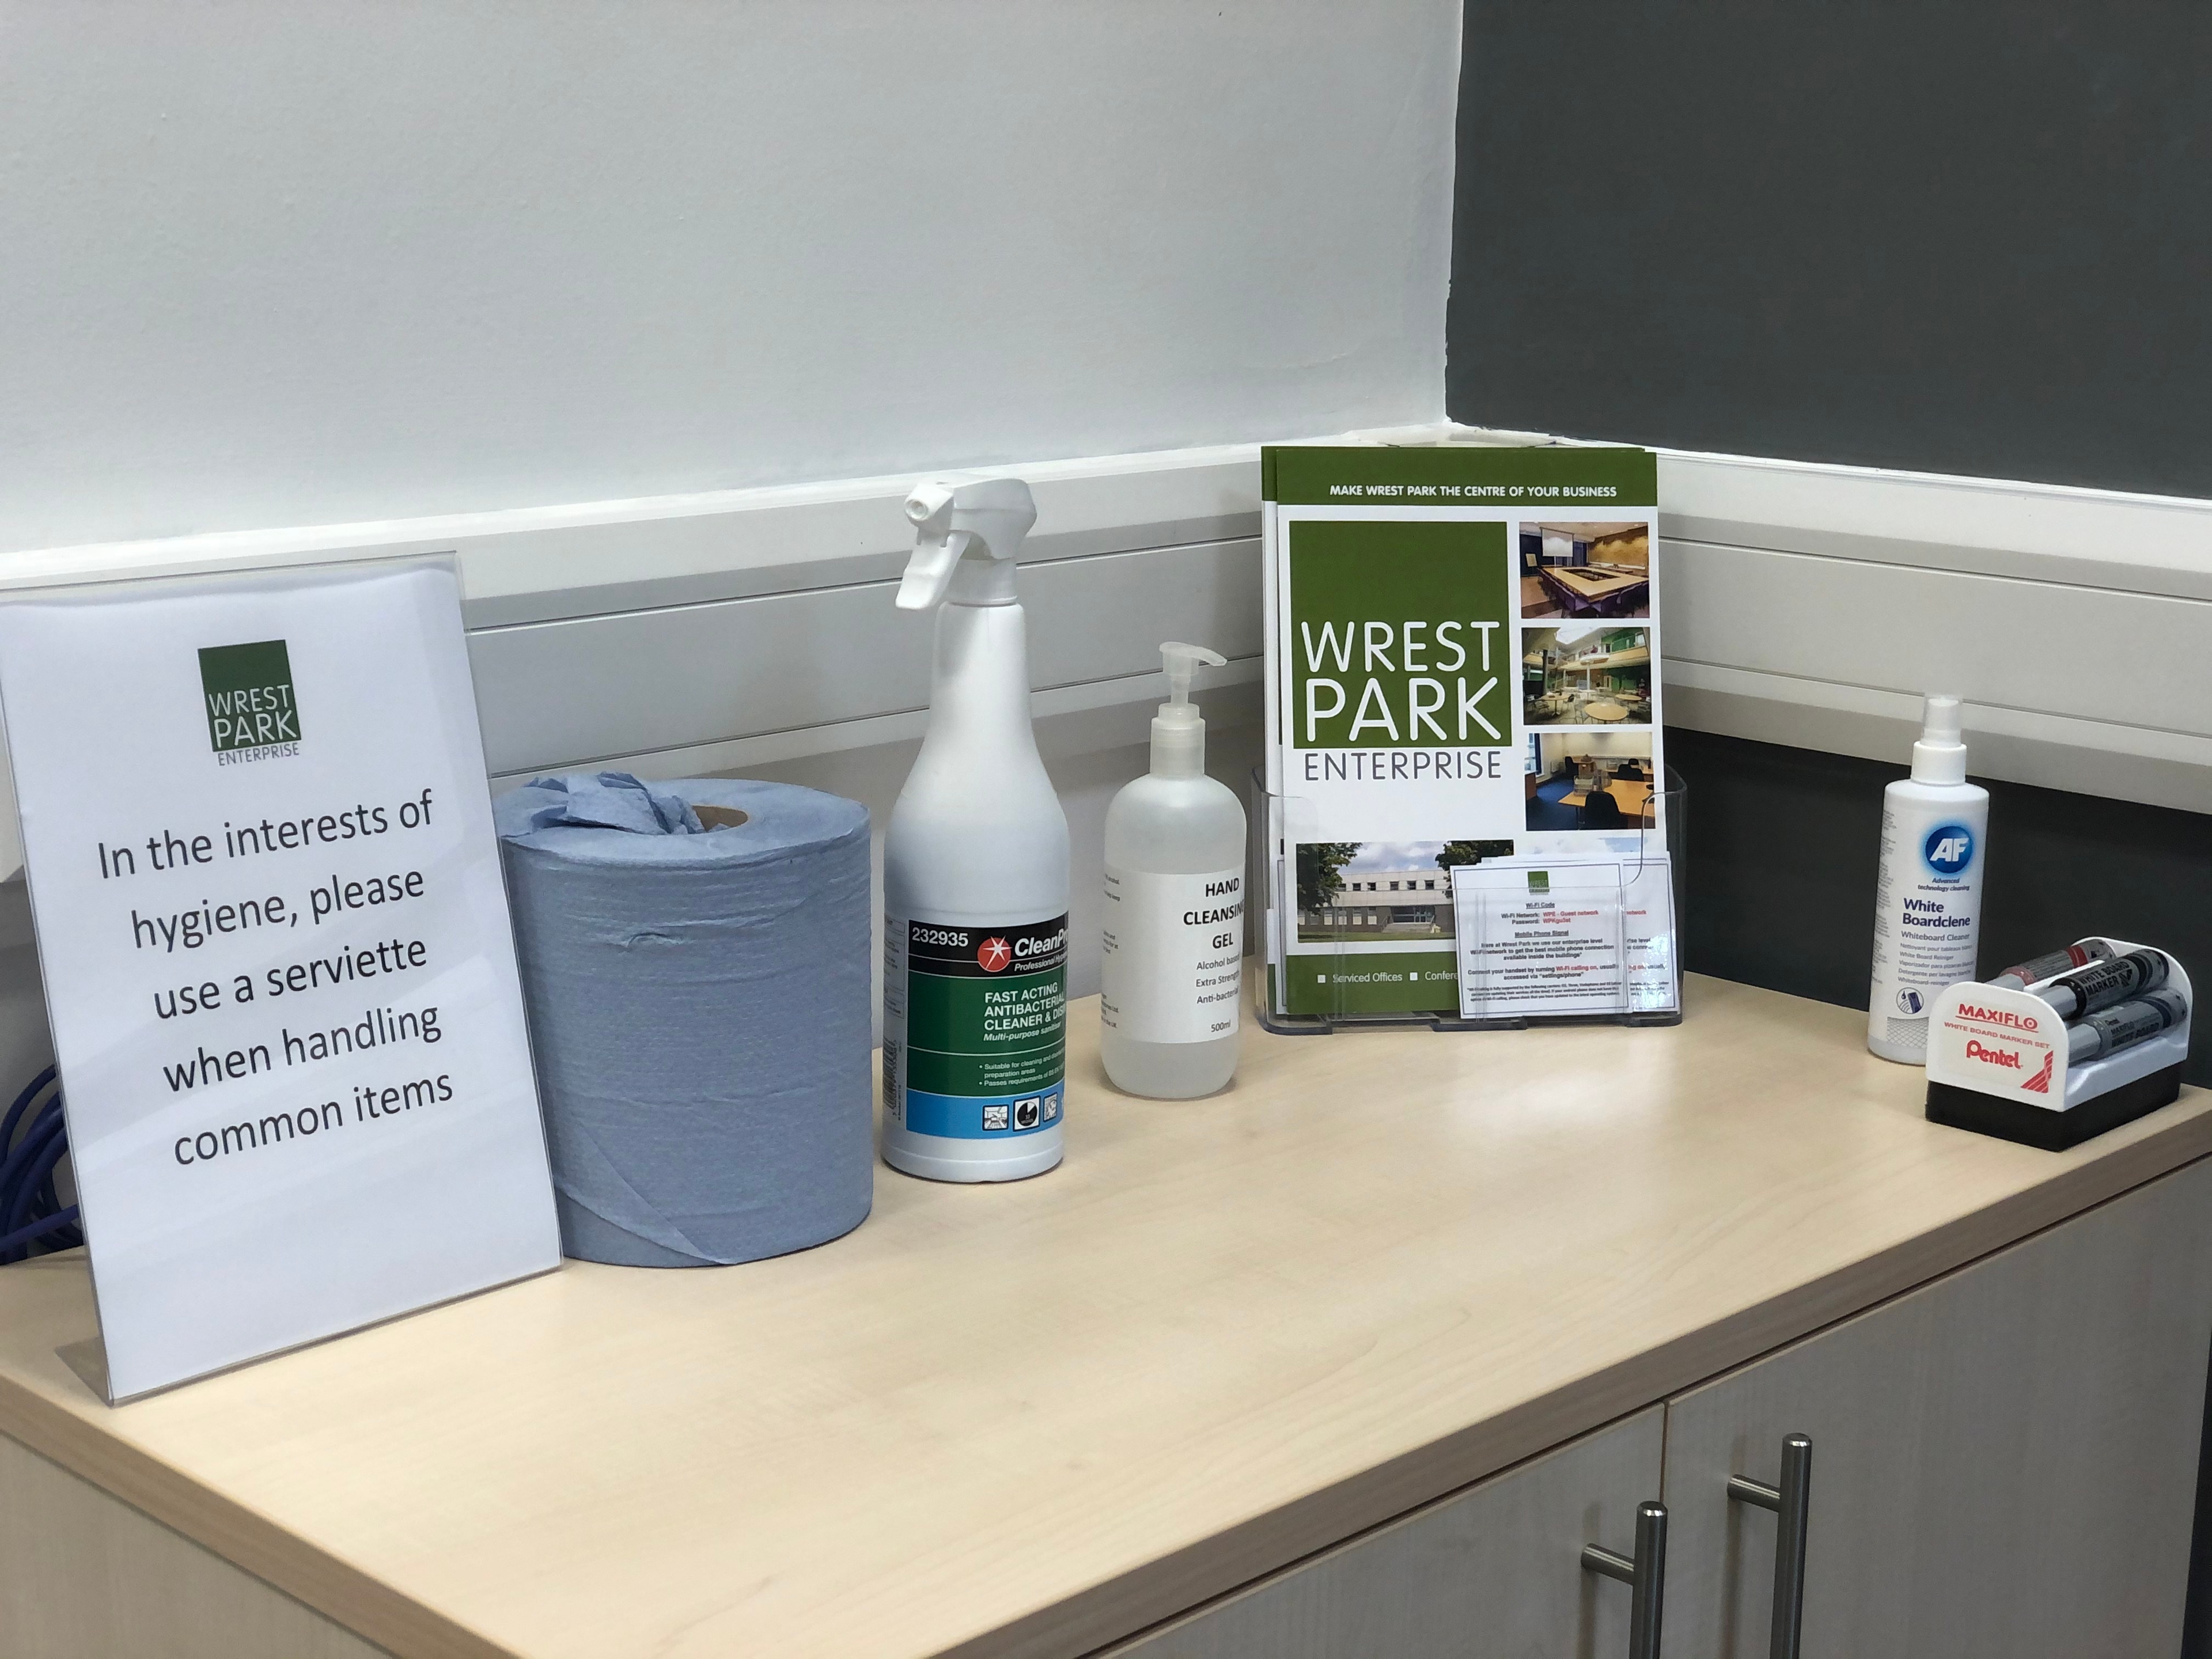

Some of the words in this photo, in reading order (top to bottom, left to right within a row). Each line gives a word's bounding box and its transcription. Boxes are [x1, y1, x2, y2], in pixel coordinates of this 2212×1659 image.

[1330, 485, 1362, 496] MAKE
[1366, 486, 1404, 496] WREST
[1407, 486, 1437, 496] PARK
[1440, 486, 1461, 497] THE
[1464, 486, 1505, 497] CENTRE
[1509, 486, 1524, 497] OF
[1527, 486, 1559, 497] YOUR
[1563, 486, 1617, 497] BUSINESS
[1300, 620, 1500, 672] WREST
[209, 684, 289, 717] WREST
[1305, 676, 1502, 742] PARK
[214, 710, 297, 748] PARK
[217, 742, 300, 766] ENTERPRISE
[1304, 749, 1502, 781] ENTERPRISE
[98, 842, 135, 878] In
[146, 830, 213, 870] the
[224, 805, 388, 858] interests
[399, 788, 433, 829] of
[1929, 838, 1969, 862] AF
[1206, 877, 1240, 897] HAND
[131, 895, 298, 952] hygiene,
[310, 870, 424, 925] please
[1903, 897, 1944, 912] White
[1903, 912, 1971, 927] Boardclene
[912, 927, 968, 947] 232935
[1212, 932, 1234, 949] GEL
[1901, 930, 1945, 941] Whiteboard
[1900, 943, 1926, 951] Nettoyant
[1014, 956, 1055, 972] Professional
[1196, 957, 1225, 970] Alcohol
[1898, 968, 1929, 976] Detergente
[1899, 960, 1930, 968] Vaporizador
[2079, 970, 2105, 984] WHITE
[2101, 961, 2130, 975] BOARD
[154, 981, 221, 1019] use
[233, 974, 254, 1003] a
[267, 939, 427, 996] serviette
[1196, 979, 1216, 987] Extra
[1332, 973, 1370, 983] Serviced
[1372, 972, 1403, 982] Offices
[2085, 975, 2119, 996] MARKER
[985, 991, 1018, 1003] FAST
[1021, 982, 1058, 1001] ACTING
[984, 991, 1065, 1017] ANTIBACTERIAL
[984, 1014, 1043, 1031] CLEANER
[1045, 1012, 1051, 1022] &
[1211, 1019, 1231, 1032] 500ml
[1959, 1003, 2038, 1029] MAXIFLO
[983, 1029, 1039, 1041] Multi-purpose
[1944, 1021, 1968, 1032] WHITE
[1969, 1027, 1998, 1038] BOARD
[1999, 1034, 2033, 1046] MARKER
[162, 1043, 272, 1092] when
[282, 1006, 442, 1066] handling
[1966, 1040, 2022, 1070] Pentel
[1021, 1058, 1043, 1067] cleaning
[984, 1070, 1020, 1079] preparation
[1008, 1074, 1043, 1085] requirements
[175, 1101, 343, 1165] common
[353, 1074, 453, 1122] items
